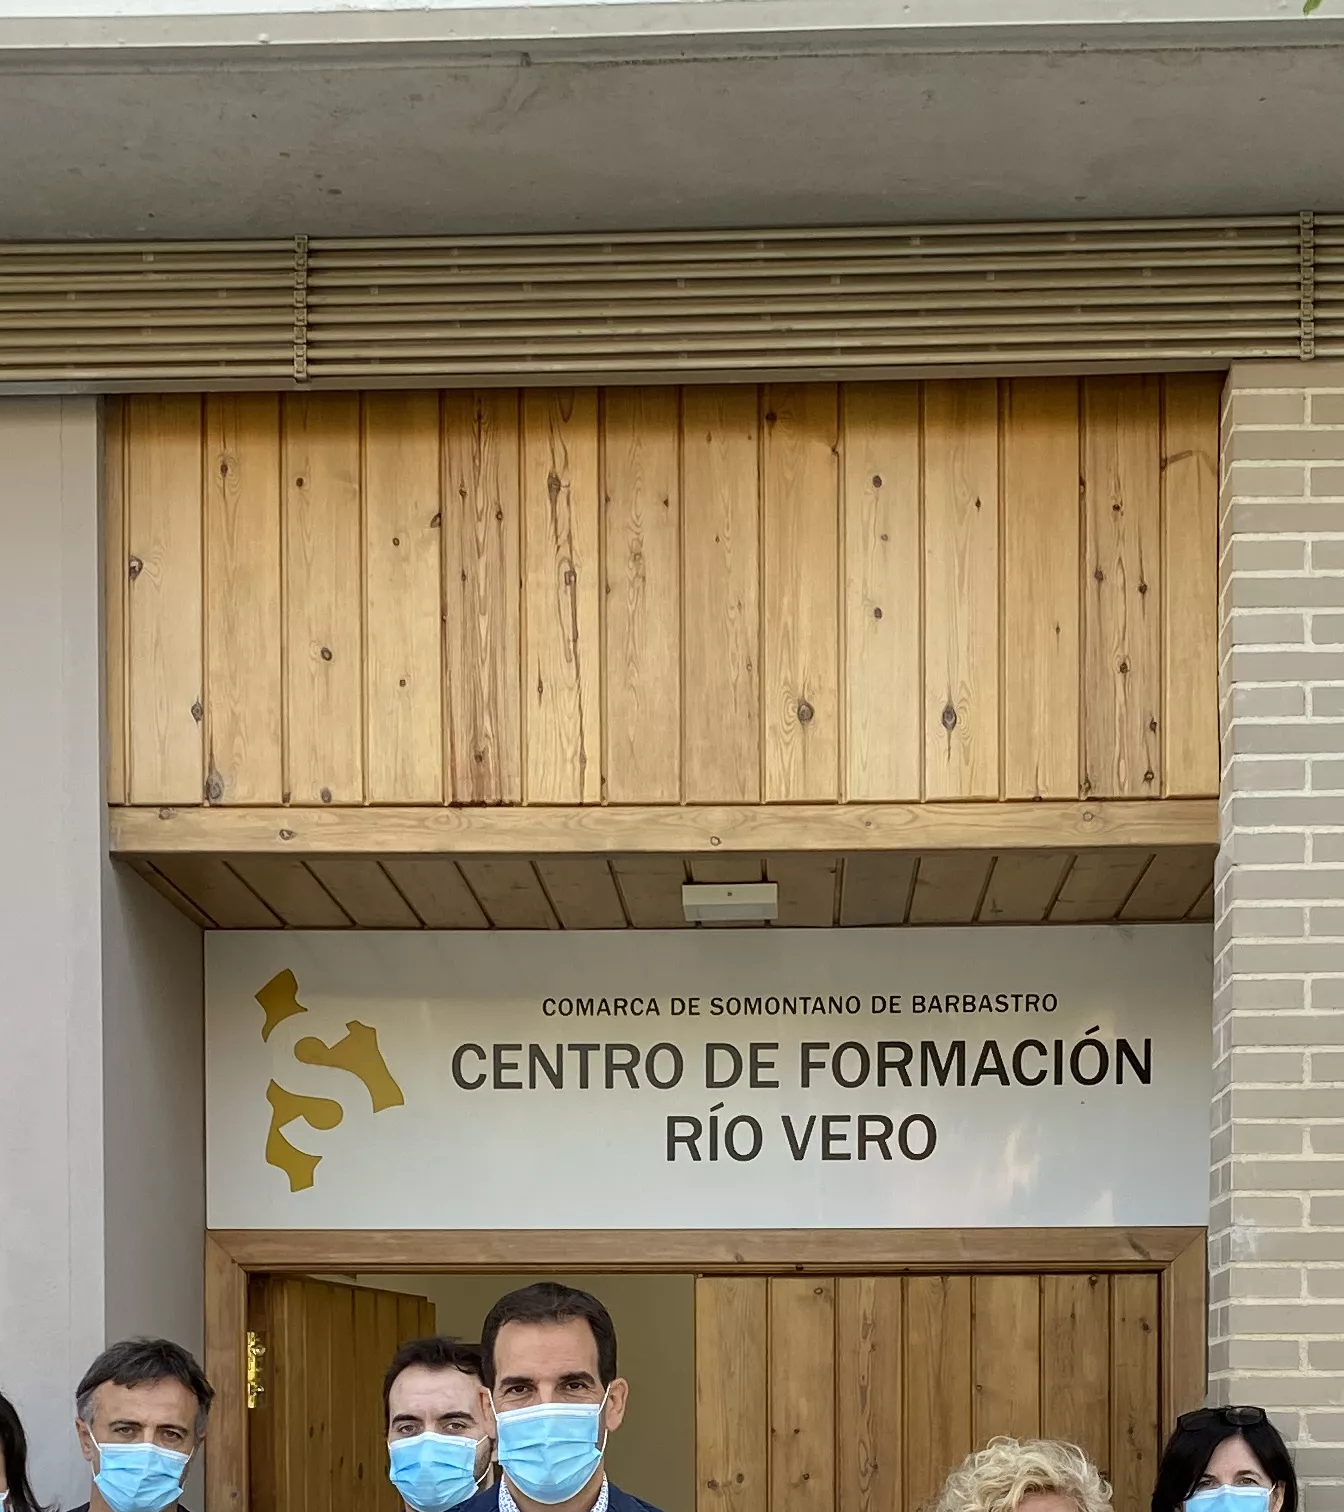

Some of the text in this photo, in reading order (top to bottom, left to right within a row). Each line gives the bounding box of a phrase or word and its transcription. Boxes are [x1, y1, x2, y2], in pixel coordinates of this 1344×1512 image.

[542, 993, 1058, 1016] COMARCA DE SOMONTANO DE BARBASTRO
[451, 1026, 1153, 1090] CENTRO DE FORMACIÓN
[666, 1101, 937, 1162] RÍO VERO
